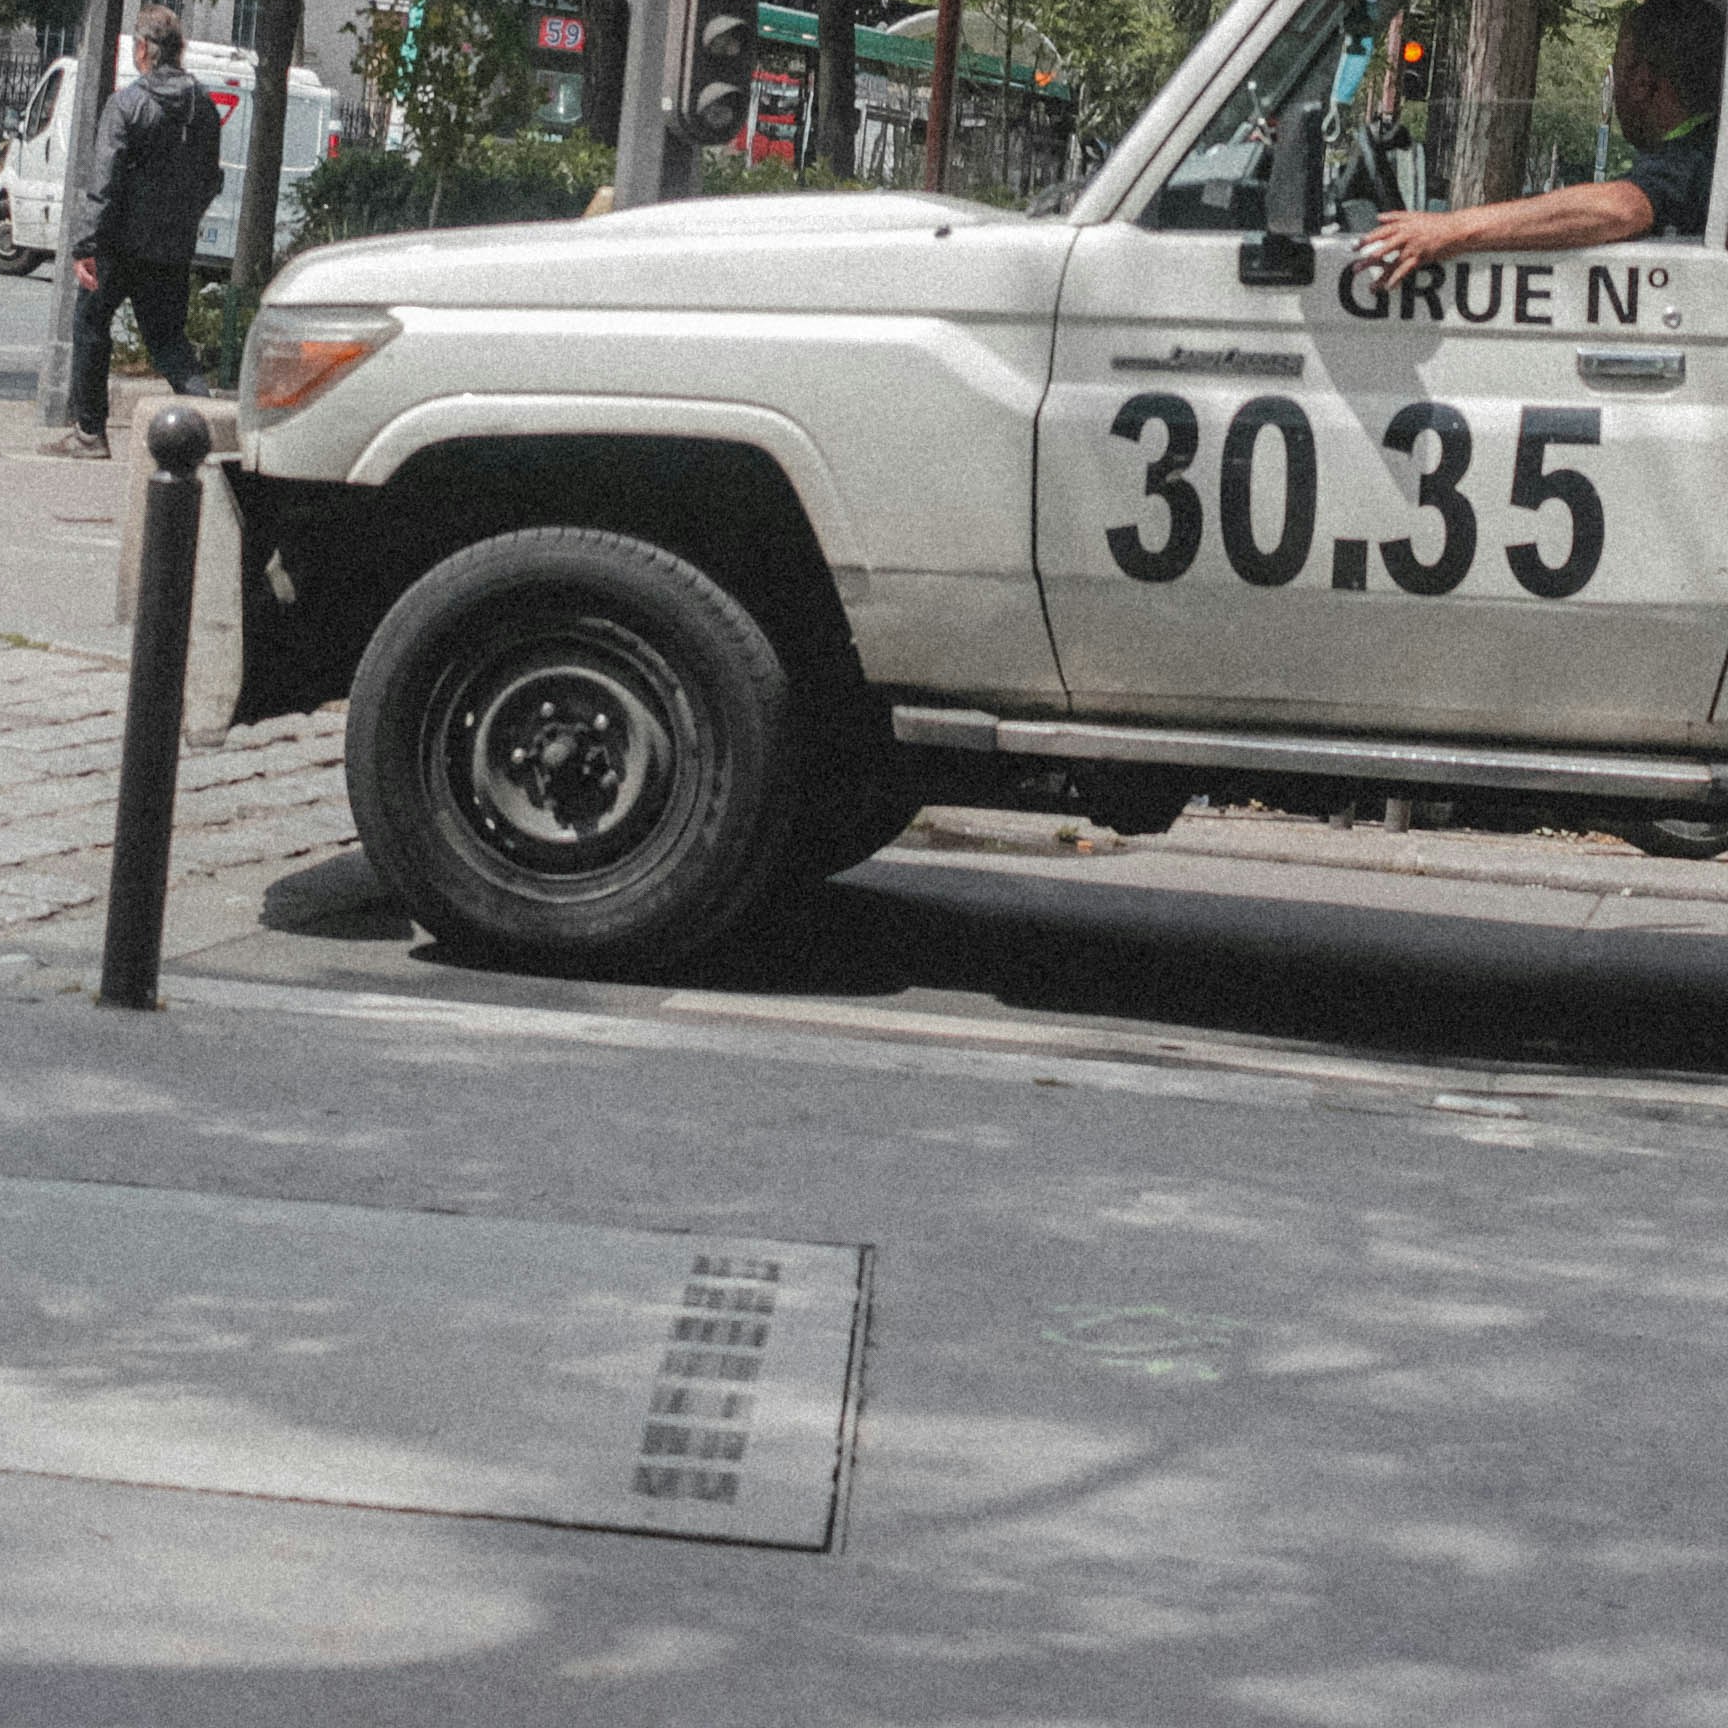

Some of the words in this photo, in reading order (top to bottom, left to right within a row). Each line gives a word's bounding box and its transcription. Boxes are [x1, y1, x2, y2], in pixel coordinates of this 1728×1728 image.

[545, 18, 582, 47] 59
[1337, 259, 1554, 325] GRUE
[1105, 391, 1605, 598] 30.35
